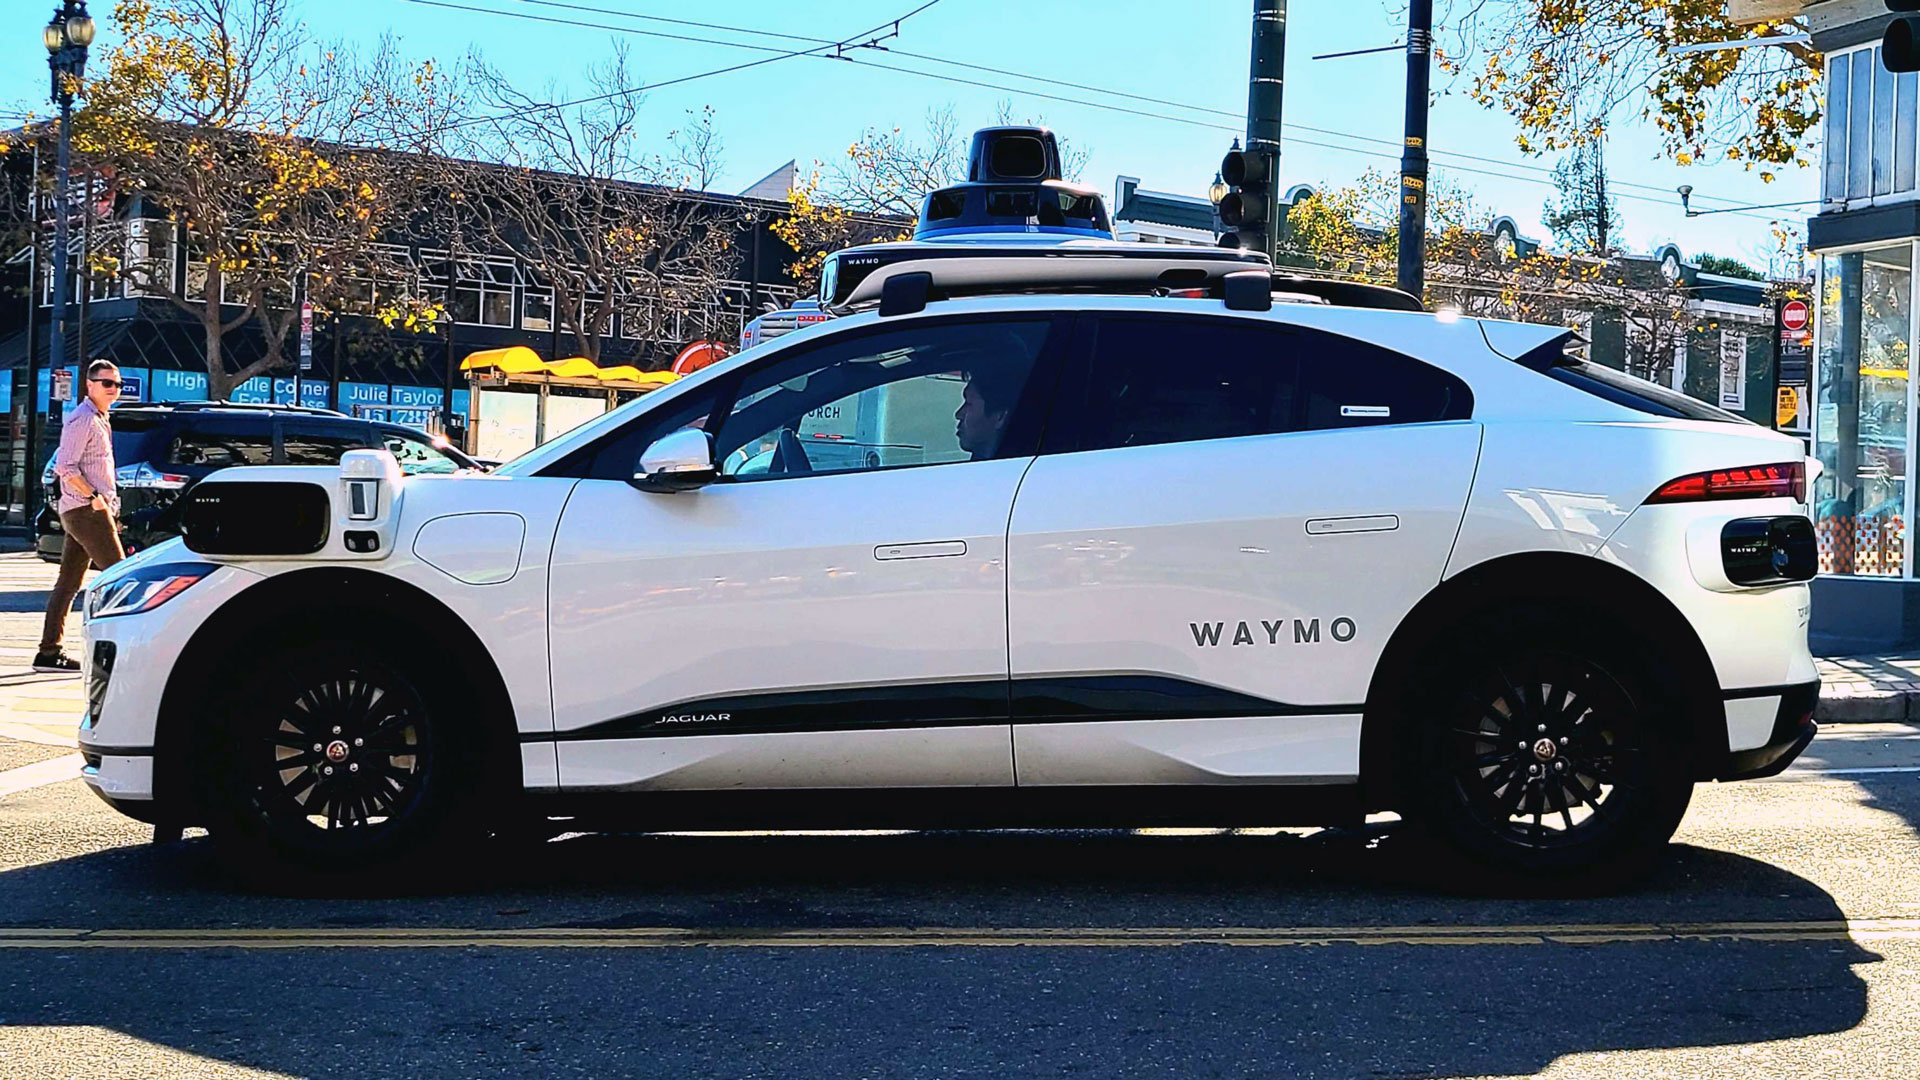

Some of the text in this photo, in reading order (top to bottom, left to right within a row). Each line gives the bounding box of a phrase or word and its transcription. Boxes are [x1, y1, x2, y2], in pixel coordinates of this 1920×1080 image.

[166, 372, 207, 390] High
[274, 379, 330, 396] Coner
[349, 386, 444, 406] Julie Taylor
[1190, 617, 1356, 647] WAYMO
[655, 713, 731, 724] JAGUAR
